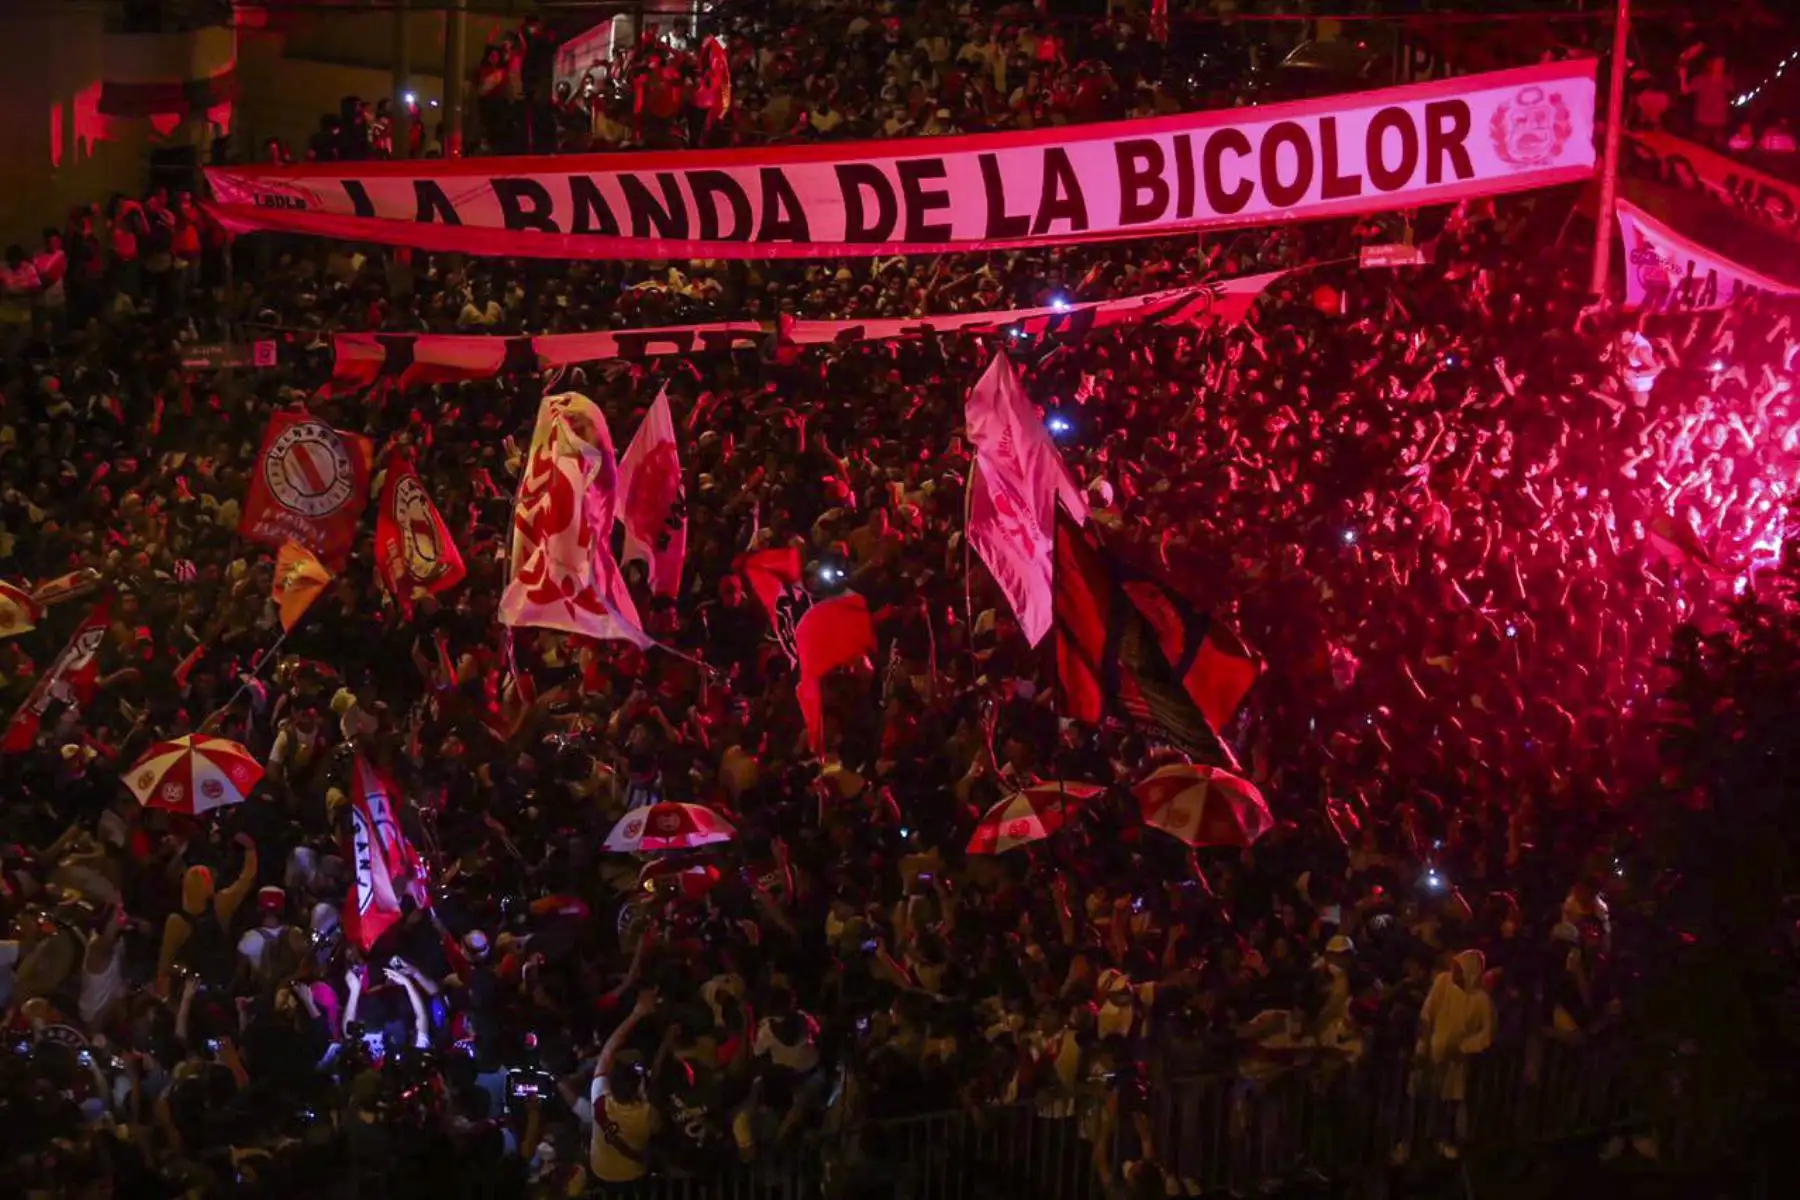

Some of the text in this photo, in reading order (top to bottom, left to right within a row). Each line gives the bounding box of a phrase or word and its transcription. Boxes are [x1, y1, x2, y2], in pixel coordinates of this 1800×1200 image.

[489, 166, 812, 243] BANDA
[834, 158, 953, 243] DE
[978, 147, 1089, 239] LA
[1114, 99, 1475, 226] BICOLOR
